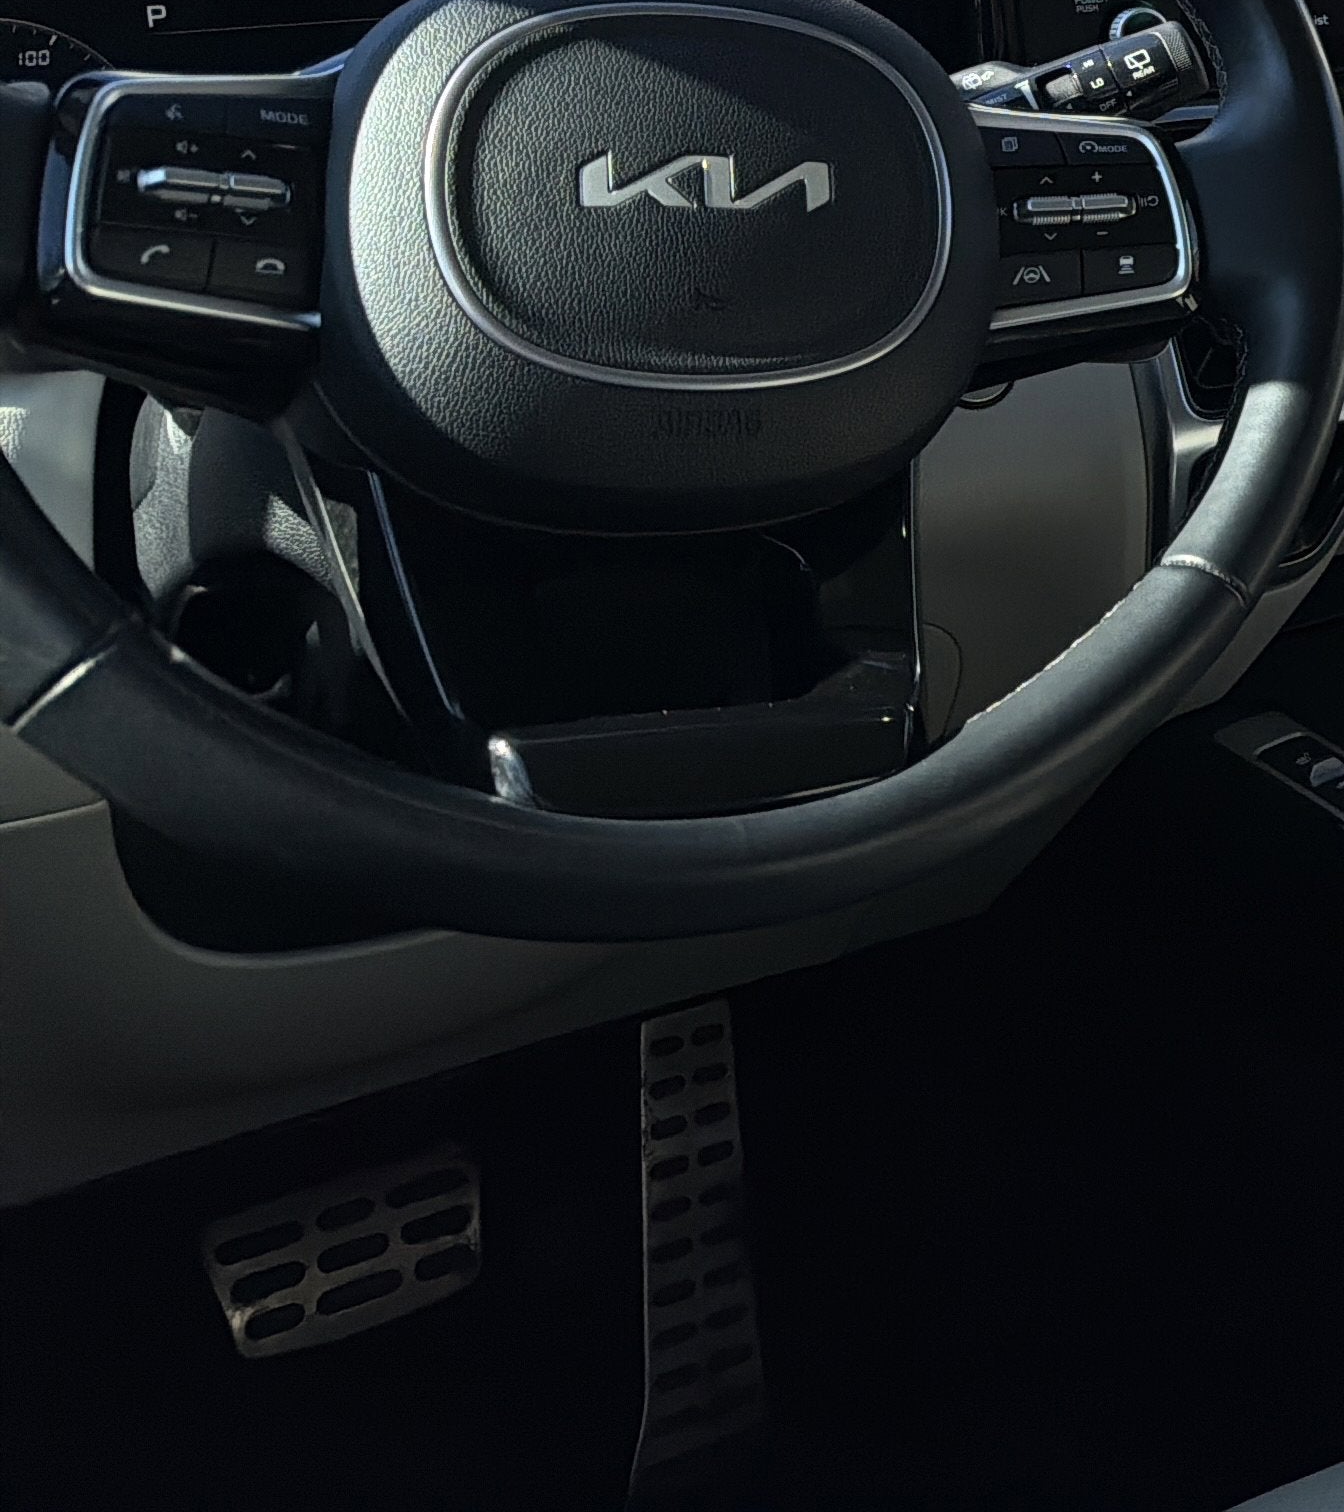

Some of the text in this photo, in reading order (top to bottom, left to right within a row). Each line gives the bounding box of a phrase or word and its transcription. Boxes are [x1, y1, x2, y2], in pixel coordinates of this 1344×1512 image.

[146, 4, 167, 28] P
[1075, 3, 1100, 14] PUSH
[17, 49, 50, 67] 100
[1099, 98, 1117, 112] OFF
[260, 108, 310, 125] MODE
[1098, 144, 1128, 154] MODE
[579, 150, 836, 213] KIA
